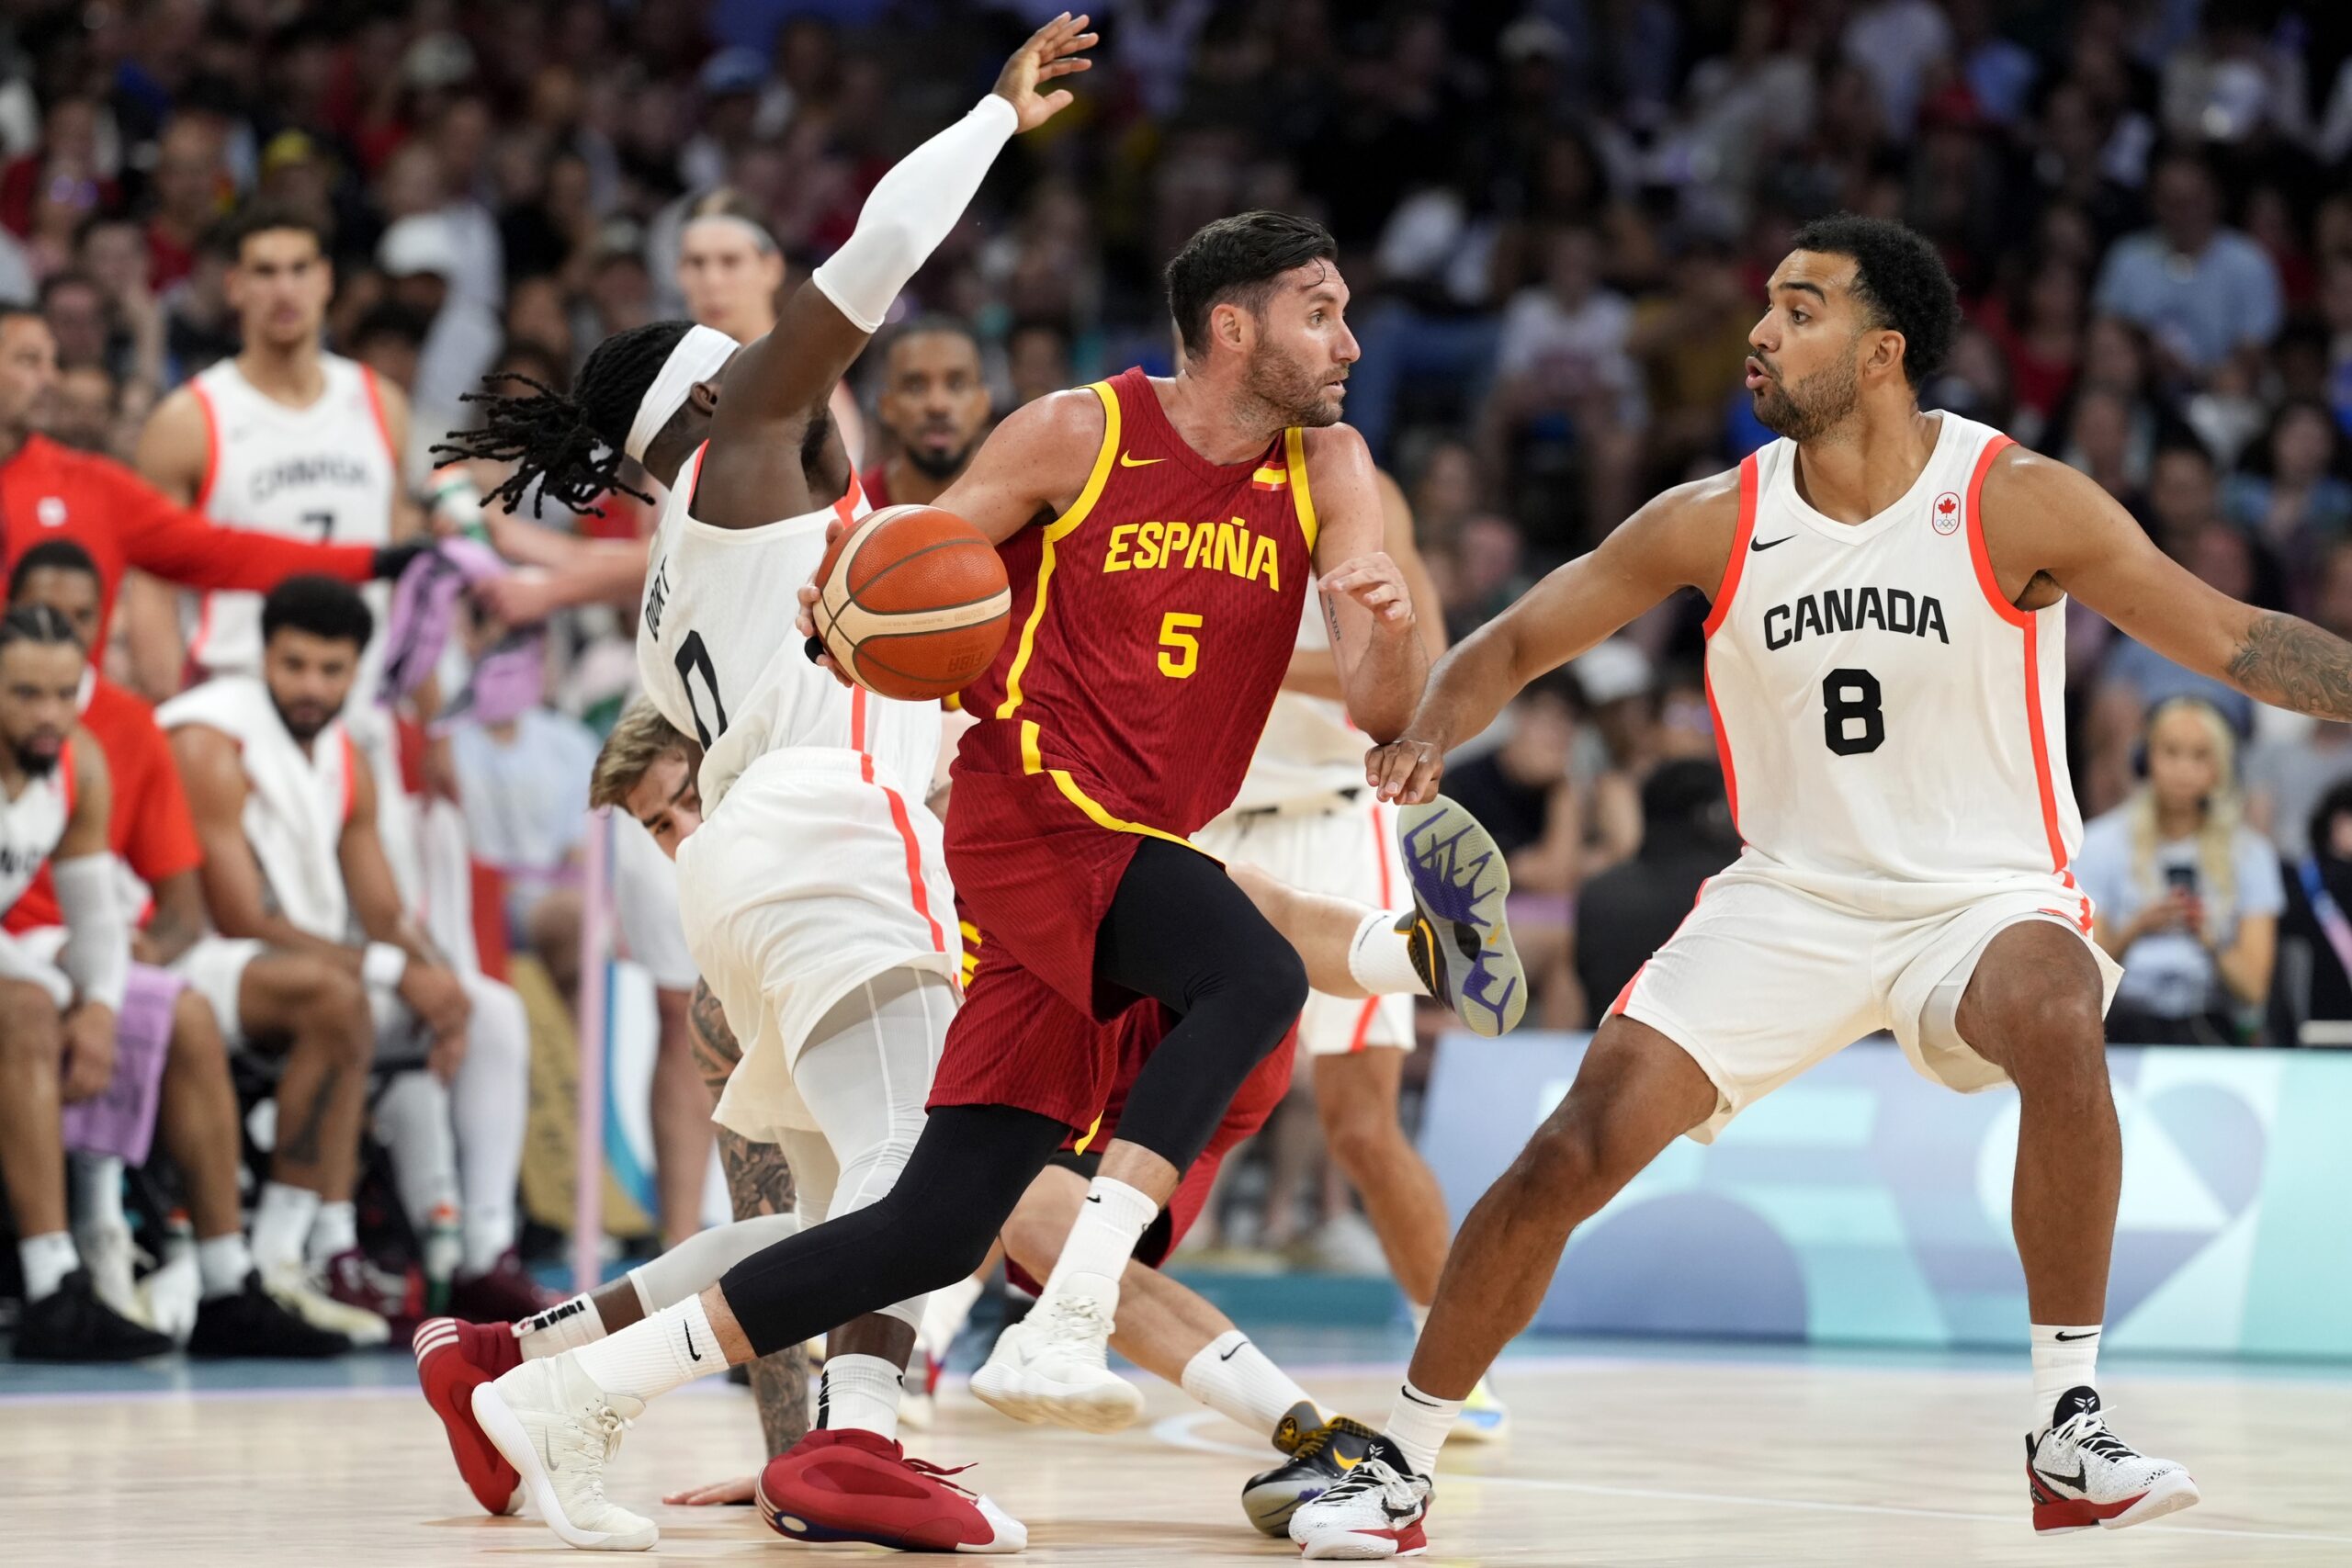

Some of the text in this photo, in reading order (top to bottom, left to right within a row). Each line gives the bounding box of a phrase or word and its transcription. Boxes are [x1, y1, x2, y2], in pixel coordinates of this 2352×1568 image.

[1102, 516, 1279, 592] ESPAÑA
[645, 554, 670, 642] DORT
[1764, 587, 1950, 651] CANADA
[1158, 612, 1204, 679] 5
[674, 629, 728, 751] 0
[1822, 669, 1884, 756] 8
